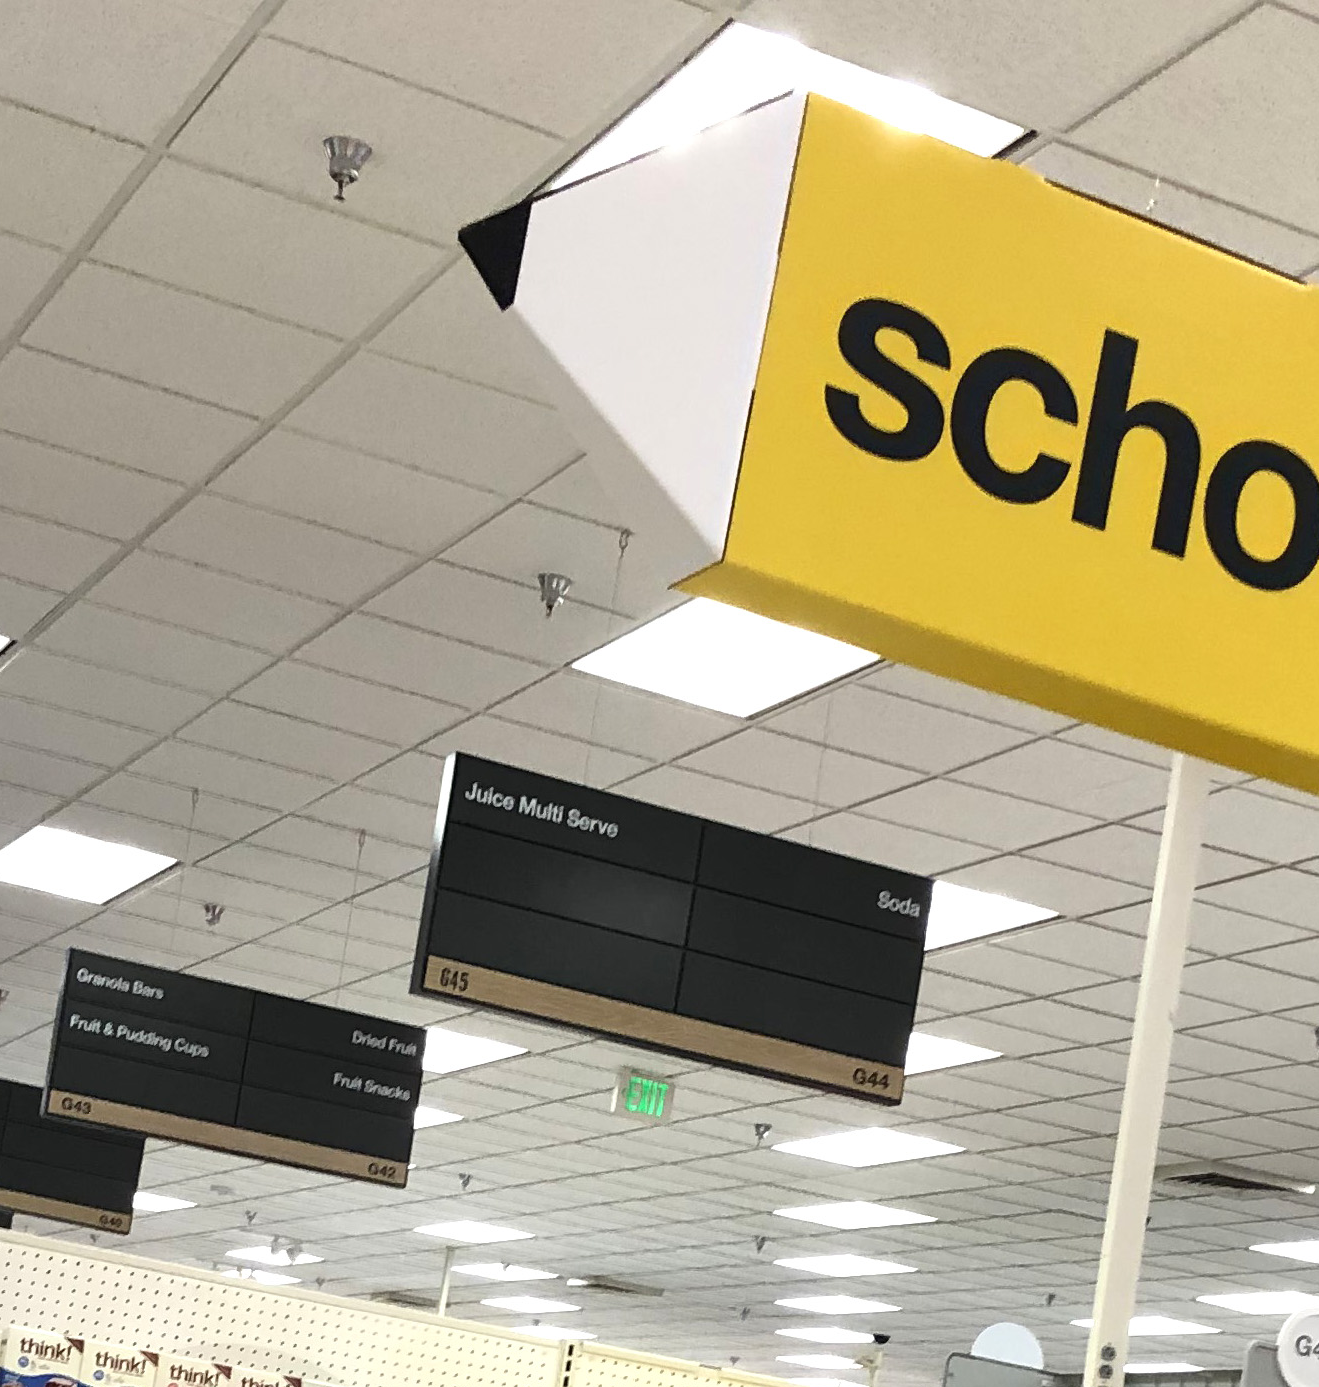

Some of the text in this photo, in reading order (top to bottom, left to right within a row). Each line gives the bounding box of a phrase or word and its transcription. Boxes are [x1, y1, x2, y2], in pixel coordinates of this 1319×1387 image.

[465, 782, 619, 838] Juice Multi Serve
[877, 890, 920, 917] Soda
[77, 967, 164, 1000] Granola Bars
[70, 1014, 209, 1058] Fruit & Pudding Cups
[352, 1030, 416, 1057] Dried Fruit
[333, 1072, 411, 1101] Fruit Snacks
[853, 1068, 889, 1089] G44
[625, 1076, 668, 1117] EXIT
[368, 1162, 396, 1179] G42
[19, 1337, 72, 1361] think!
[95, 1351, 146, 1375] think!
[169, 1364, 220, 1387] think!
